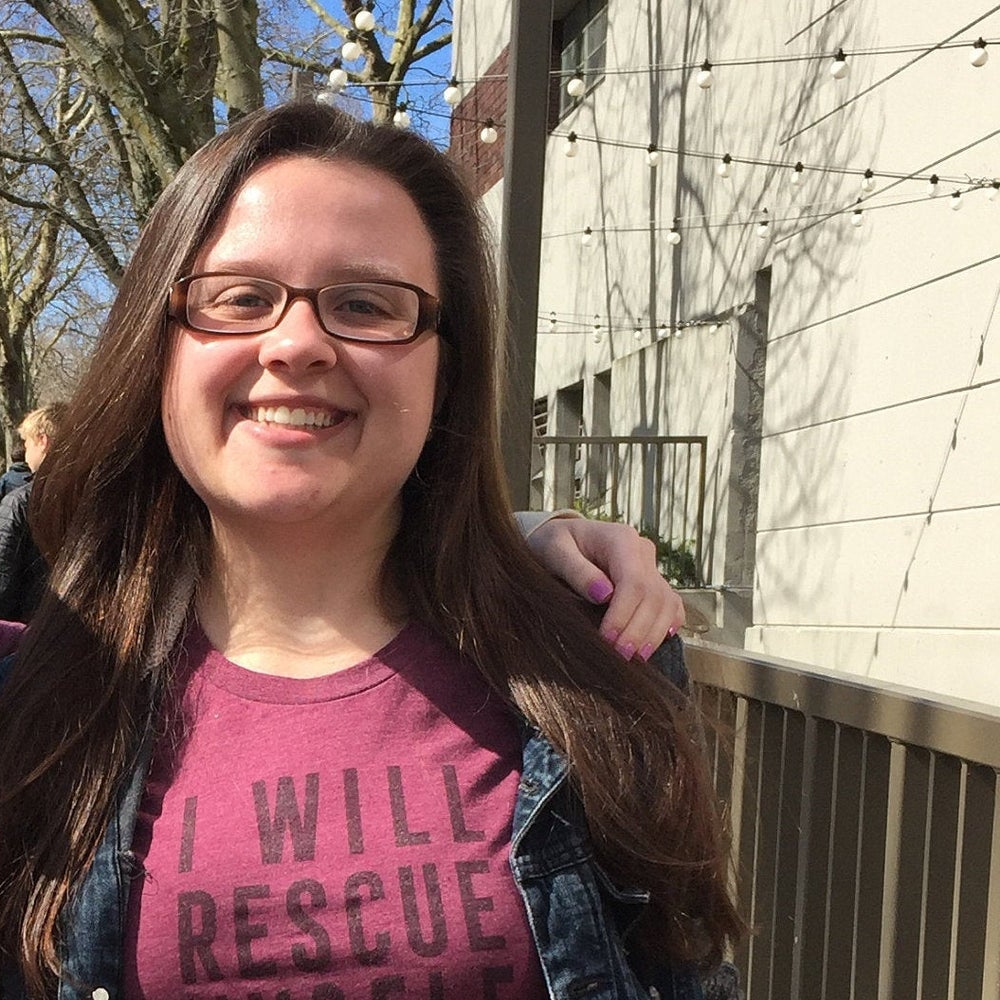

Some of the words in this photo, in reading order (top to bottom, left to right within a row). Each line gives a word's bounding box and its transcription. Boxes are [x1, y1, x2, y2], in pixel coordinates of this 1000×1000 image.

[178, 795, 198, 873] I
[251, 764, 486, 866] WILL
[176, 859, 508, 985] RESCUE
